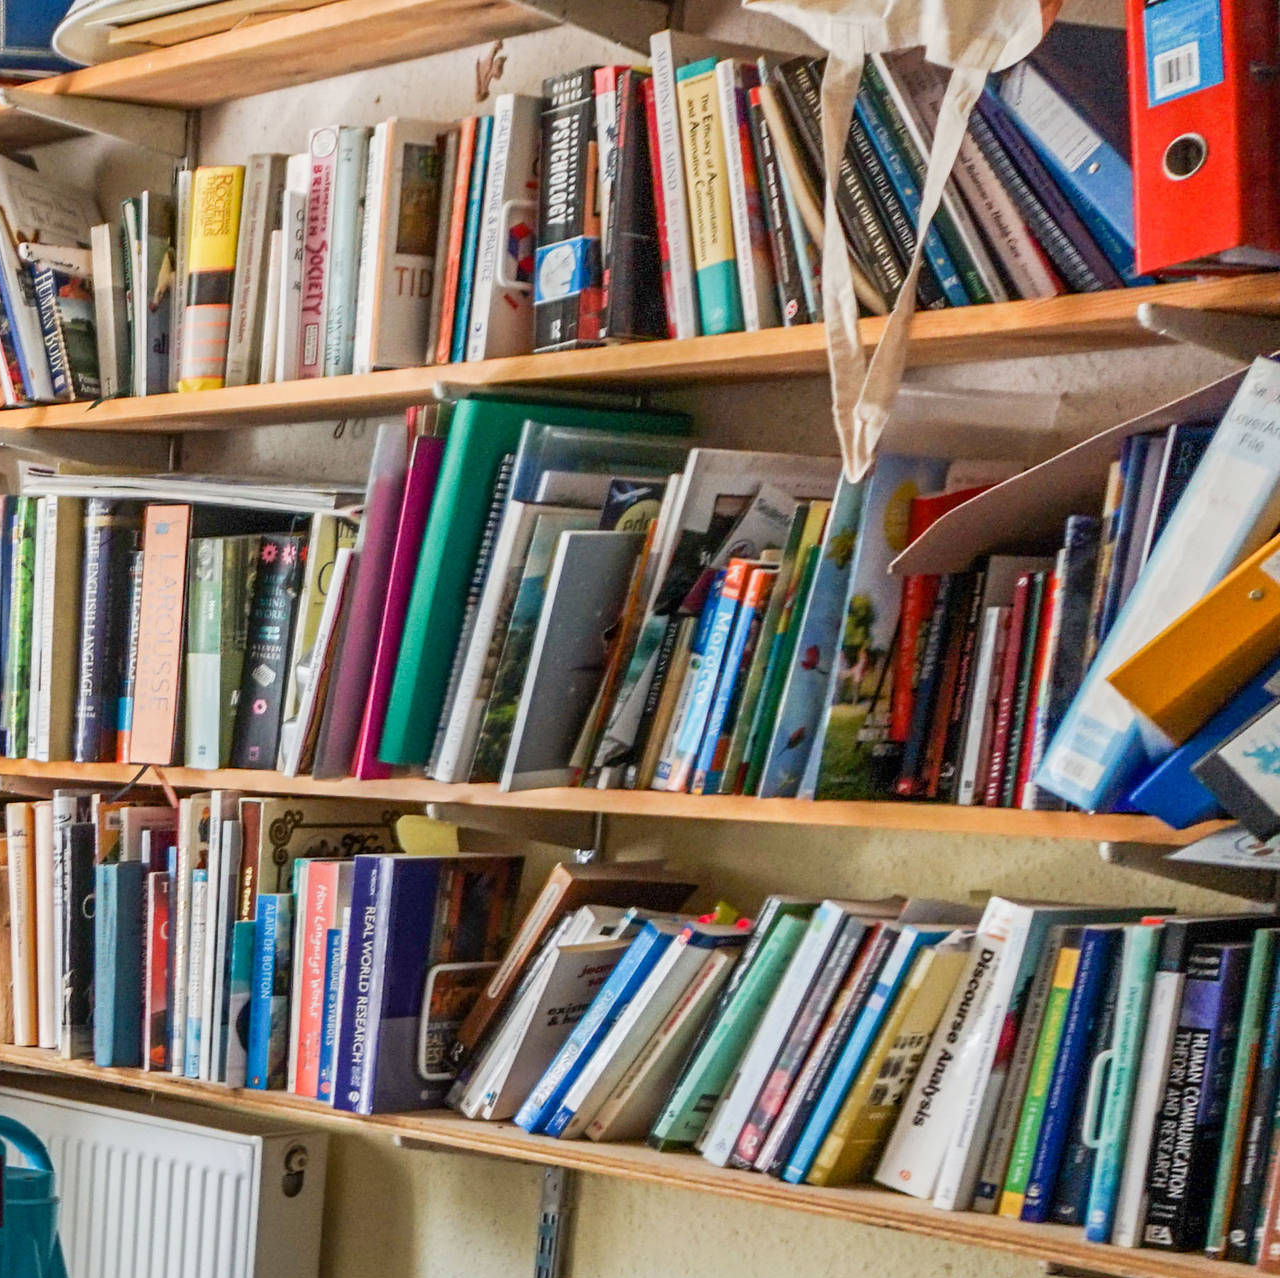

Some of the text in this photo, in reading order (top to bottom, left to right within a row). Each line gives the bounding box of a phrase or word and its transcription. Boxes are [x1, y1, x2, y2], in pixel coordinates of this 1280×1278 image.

[495, 108, 511, 153] HEALTH
[547, 114, 571, 225] PSYCHOLOGY
[654, 48, 672, 115] MAPPING
[663, 150, 677, 191] MIND
[701, 94, 720, 246] The Efficacy of Augmentative
[488, 159, 505, 212] WELFARE
[687, 100, 709, 262] and Alternative Communication
[299, 164, 328, 315] BRITISH SOCIETY
[481, 228, 497, 282] PRACTICE
[858, 201, 903, 290] COMMUNICATION
[35, 269, 67, 373] HUMAN BODY
[80, 530, 100, 695] THE ENGLISH LANGUAGE
[150, 552, 178, 712] LAROUSSE
[696, 612, 731, 703] Morocco
[260, 903, 275, 998] ALAIN DE BOTTON
[306, 884, 329, 1017] How Language Works
[329, 947, 339, 990] LANGUAGE
[357, 941, 373, 991] WORLD
[362, 905, 376, 937] REAL
[325, 1002, 336, 1046] SYMBOLS
[351, 995, 368, 1063] RESEARCH
[910, 946, 996, 1129] Discourse Analysis
[1152, 1029, 1191, 1188] THEORY AND RESEARCH
[1167, 1031, 1209, 1197] HUMAN COMMUNICATION
